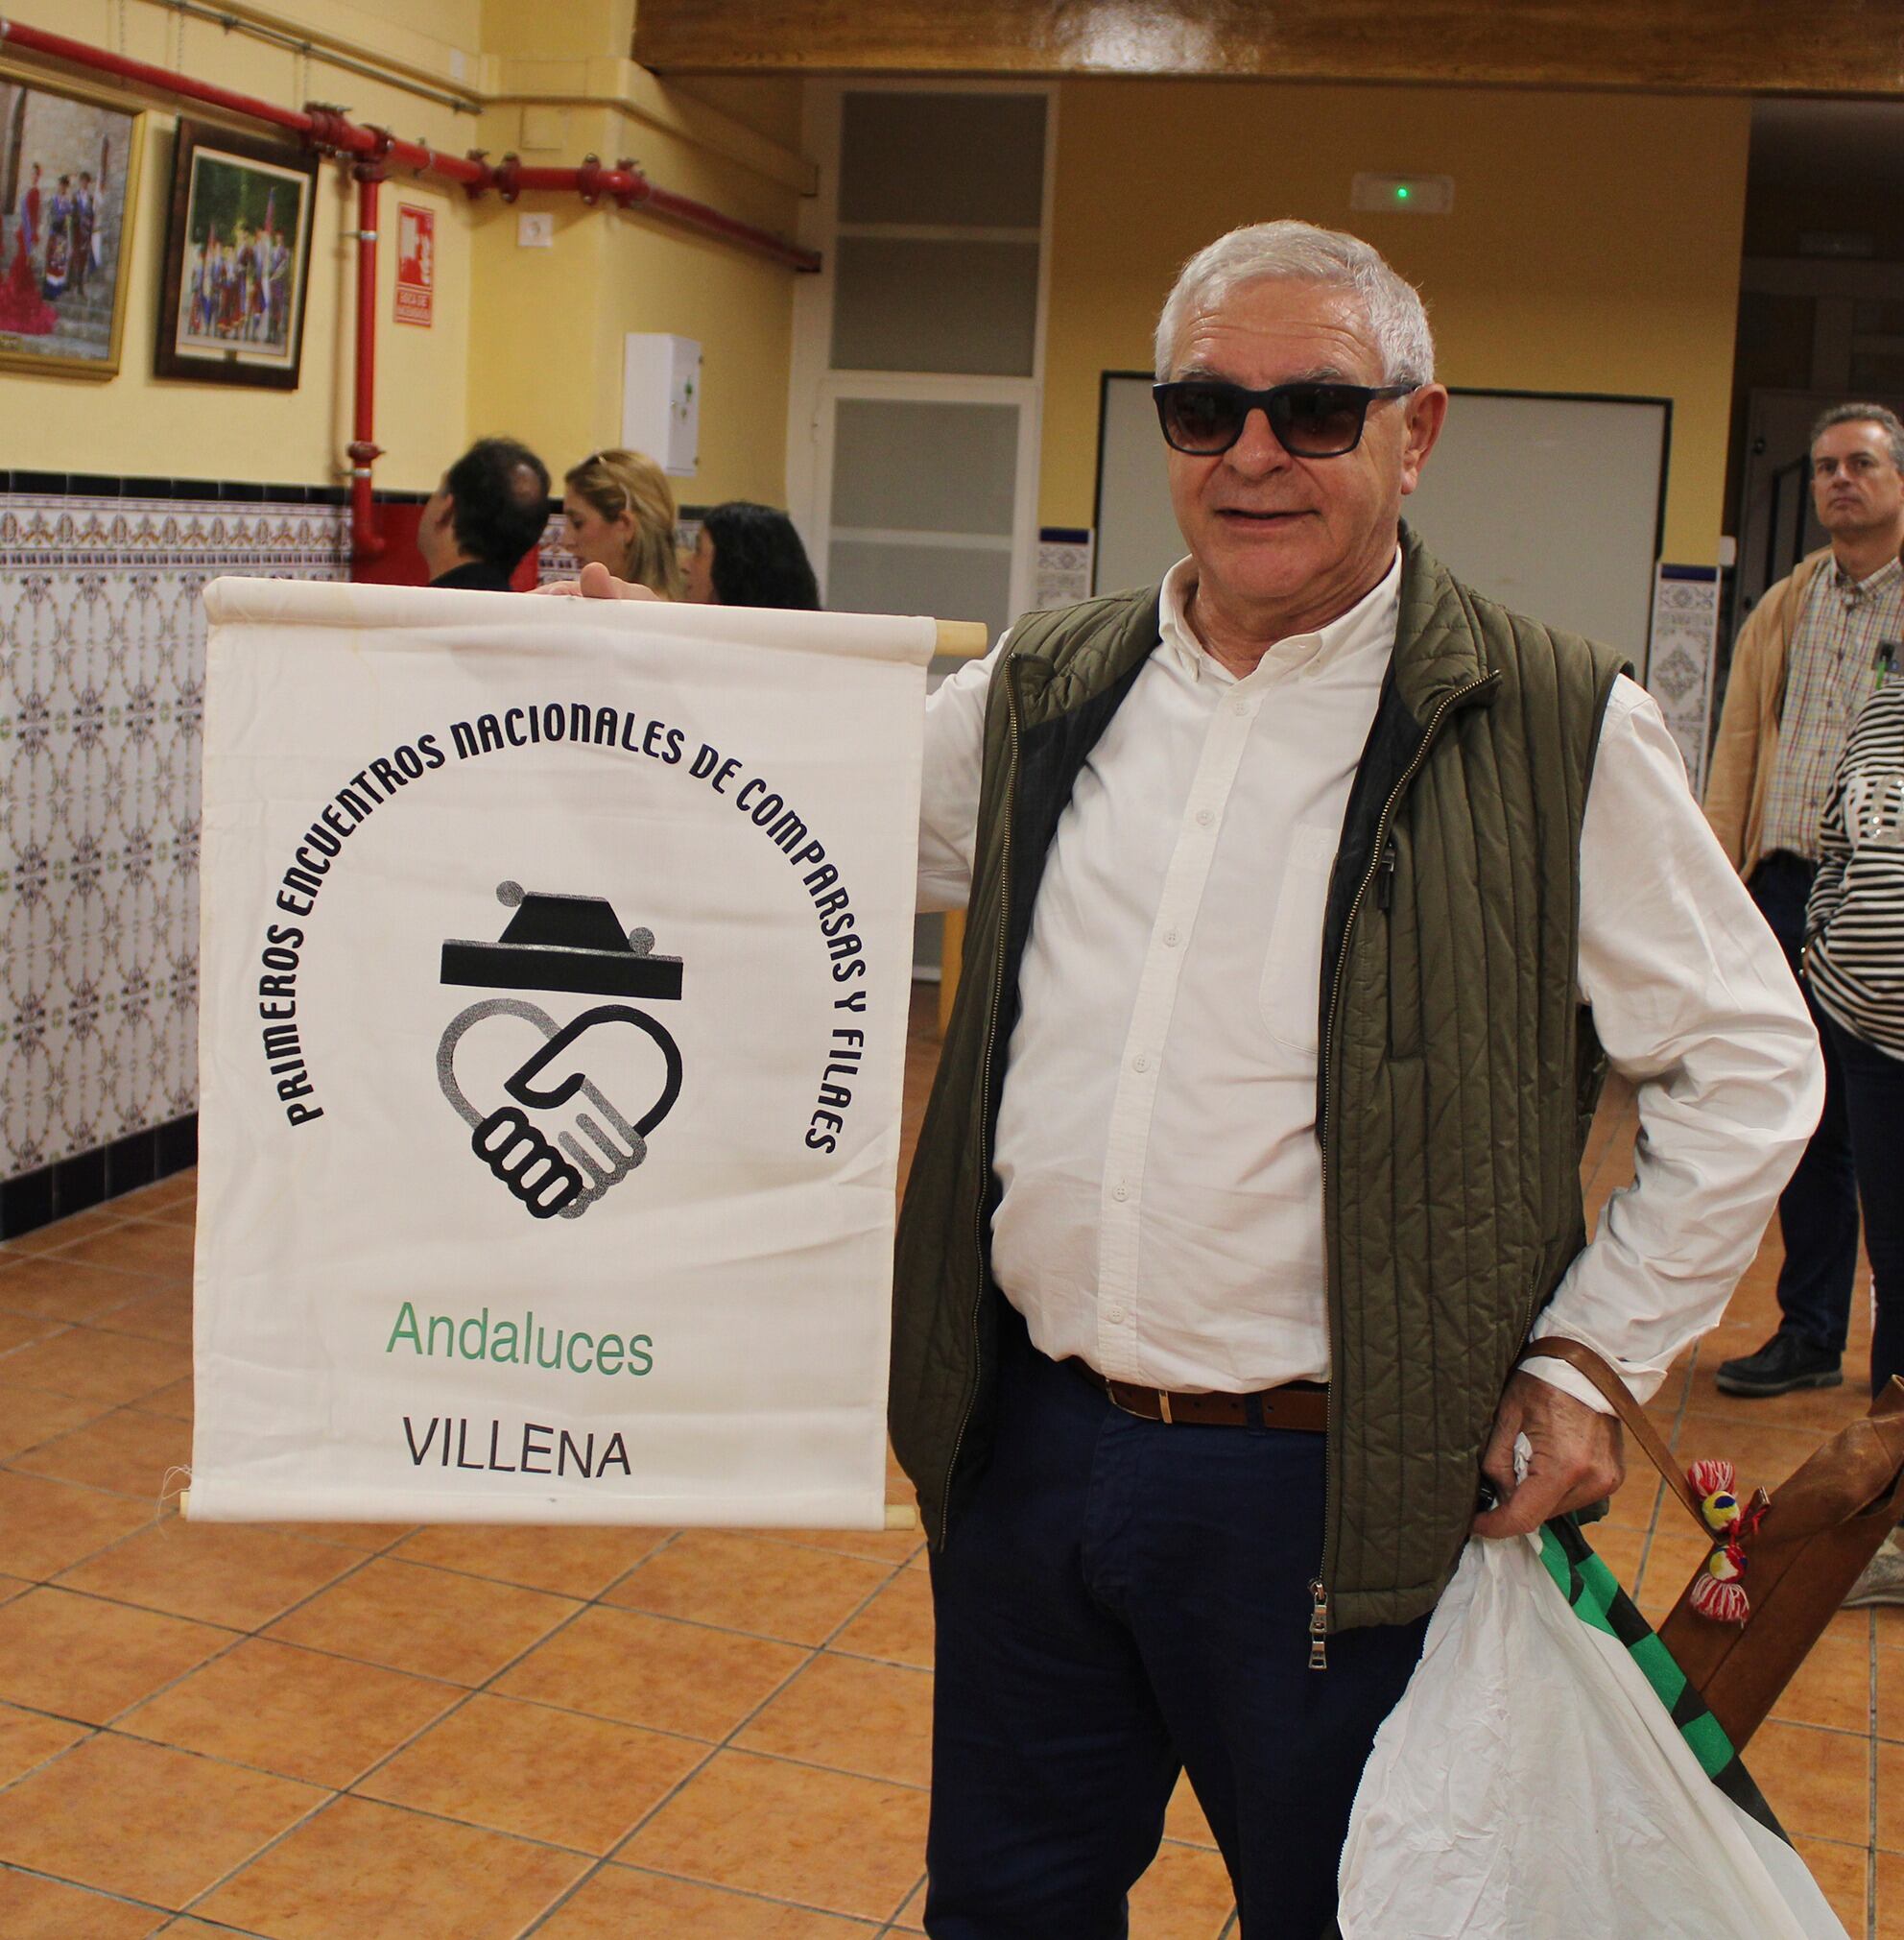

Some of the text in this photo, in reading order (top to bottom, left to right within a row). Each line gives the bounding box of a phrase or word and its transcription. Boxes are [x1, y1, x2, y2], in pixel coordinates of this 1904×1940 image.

[258, 703, 867, 1154] PRIMEROS ENCUENTROS NACIONALES DE COMPARSAS Y FILAES
[386, 1302, 654, 1377] Andaluces
[402, 1416, 631, 1478] VILLENA
